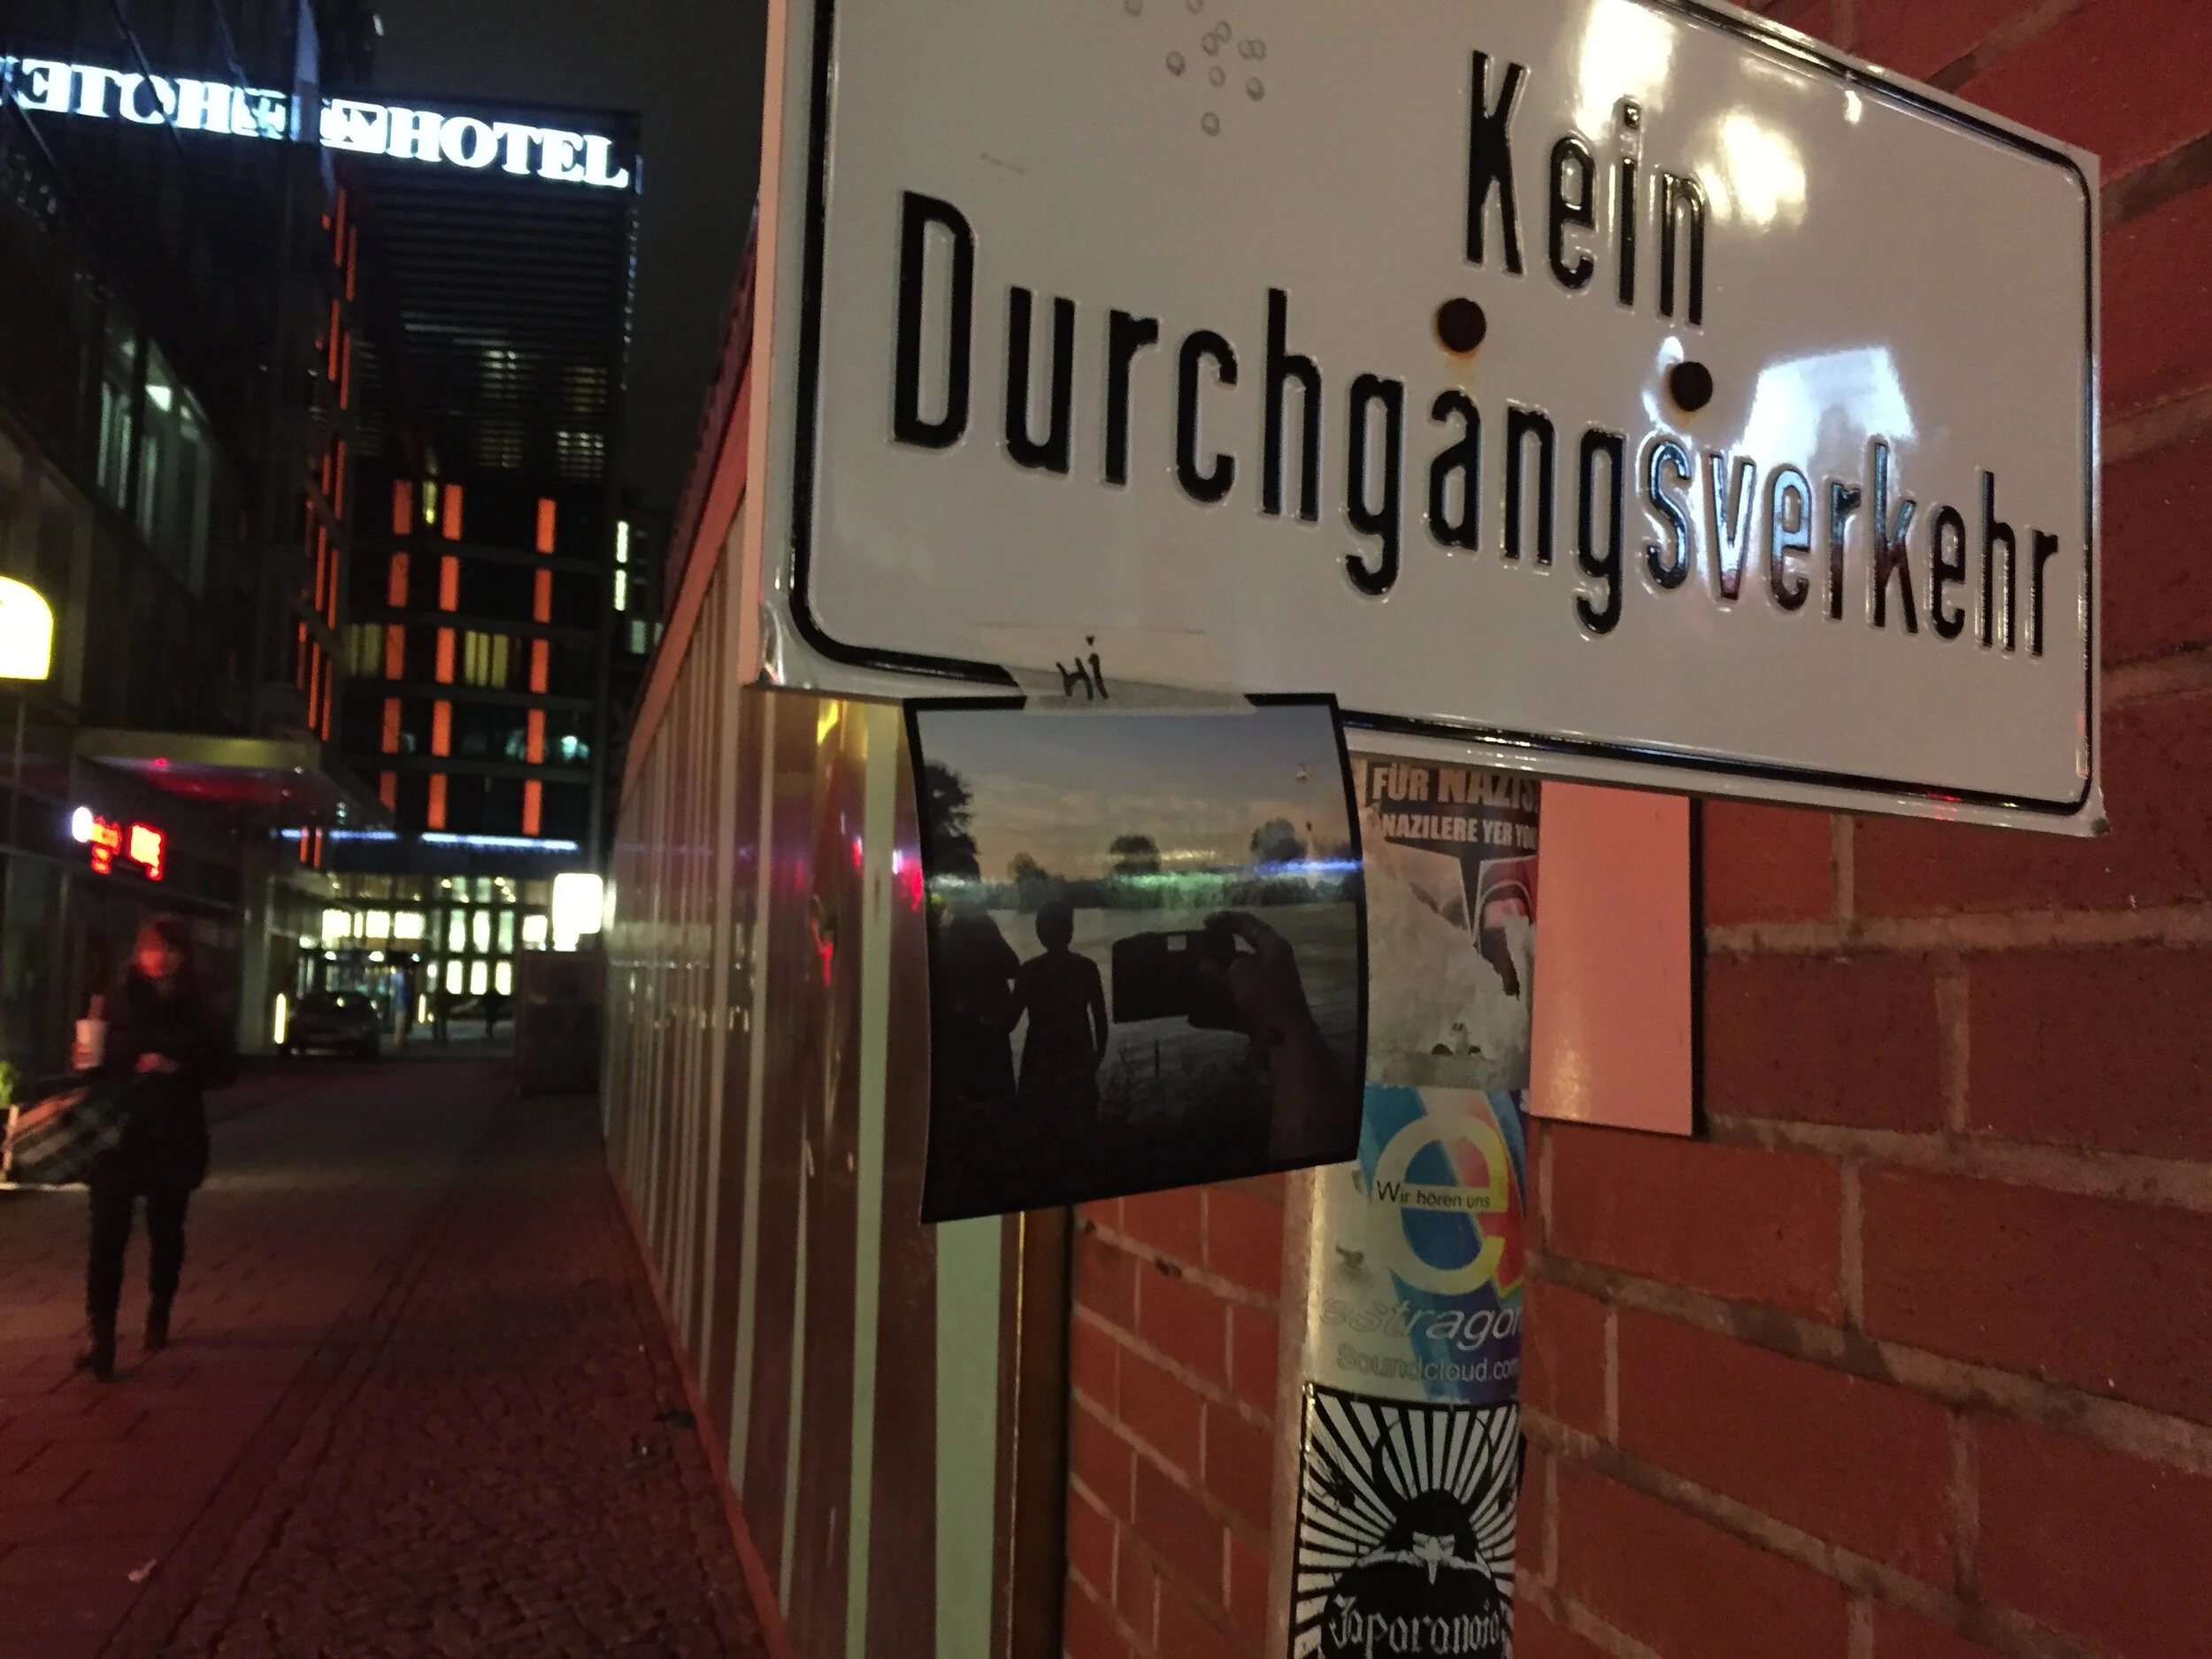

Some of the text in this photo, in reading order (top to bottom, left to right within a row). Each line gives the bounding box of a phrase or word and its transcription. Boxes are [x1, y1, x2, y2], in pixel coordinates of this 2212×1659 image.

[386, 105, 629, 188] HOTEL
[1464, 49, 1708, 326] Kein
[892, 189, 2060, 658] Durchgangsverkehr
[1372, 763, 1428, 802] FÜR
[1382, 813, 1478, 841] NAZILERE
[1483, 820, 1512, 846] YER
[1377, 1180, 1490, 1209] Wir hören uns
